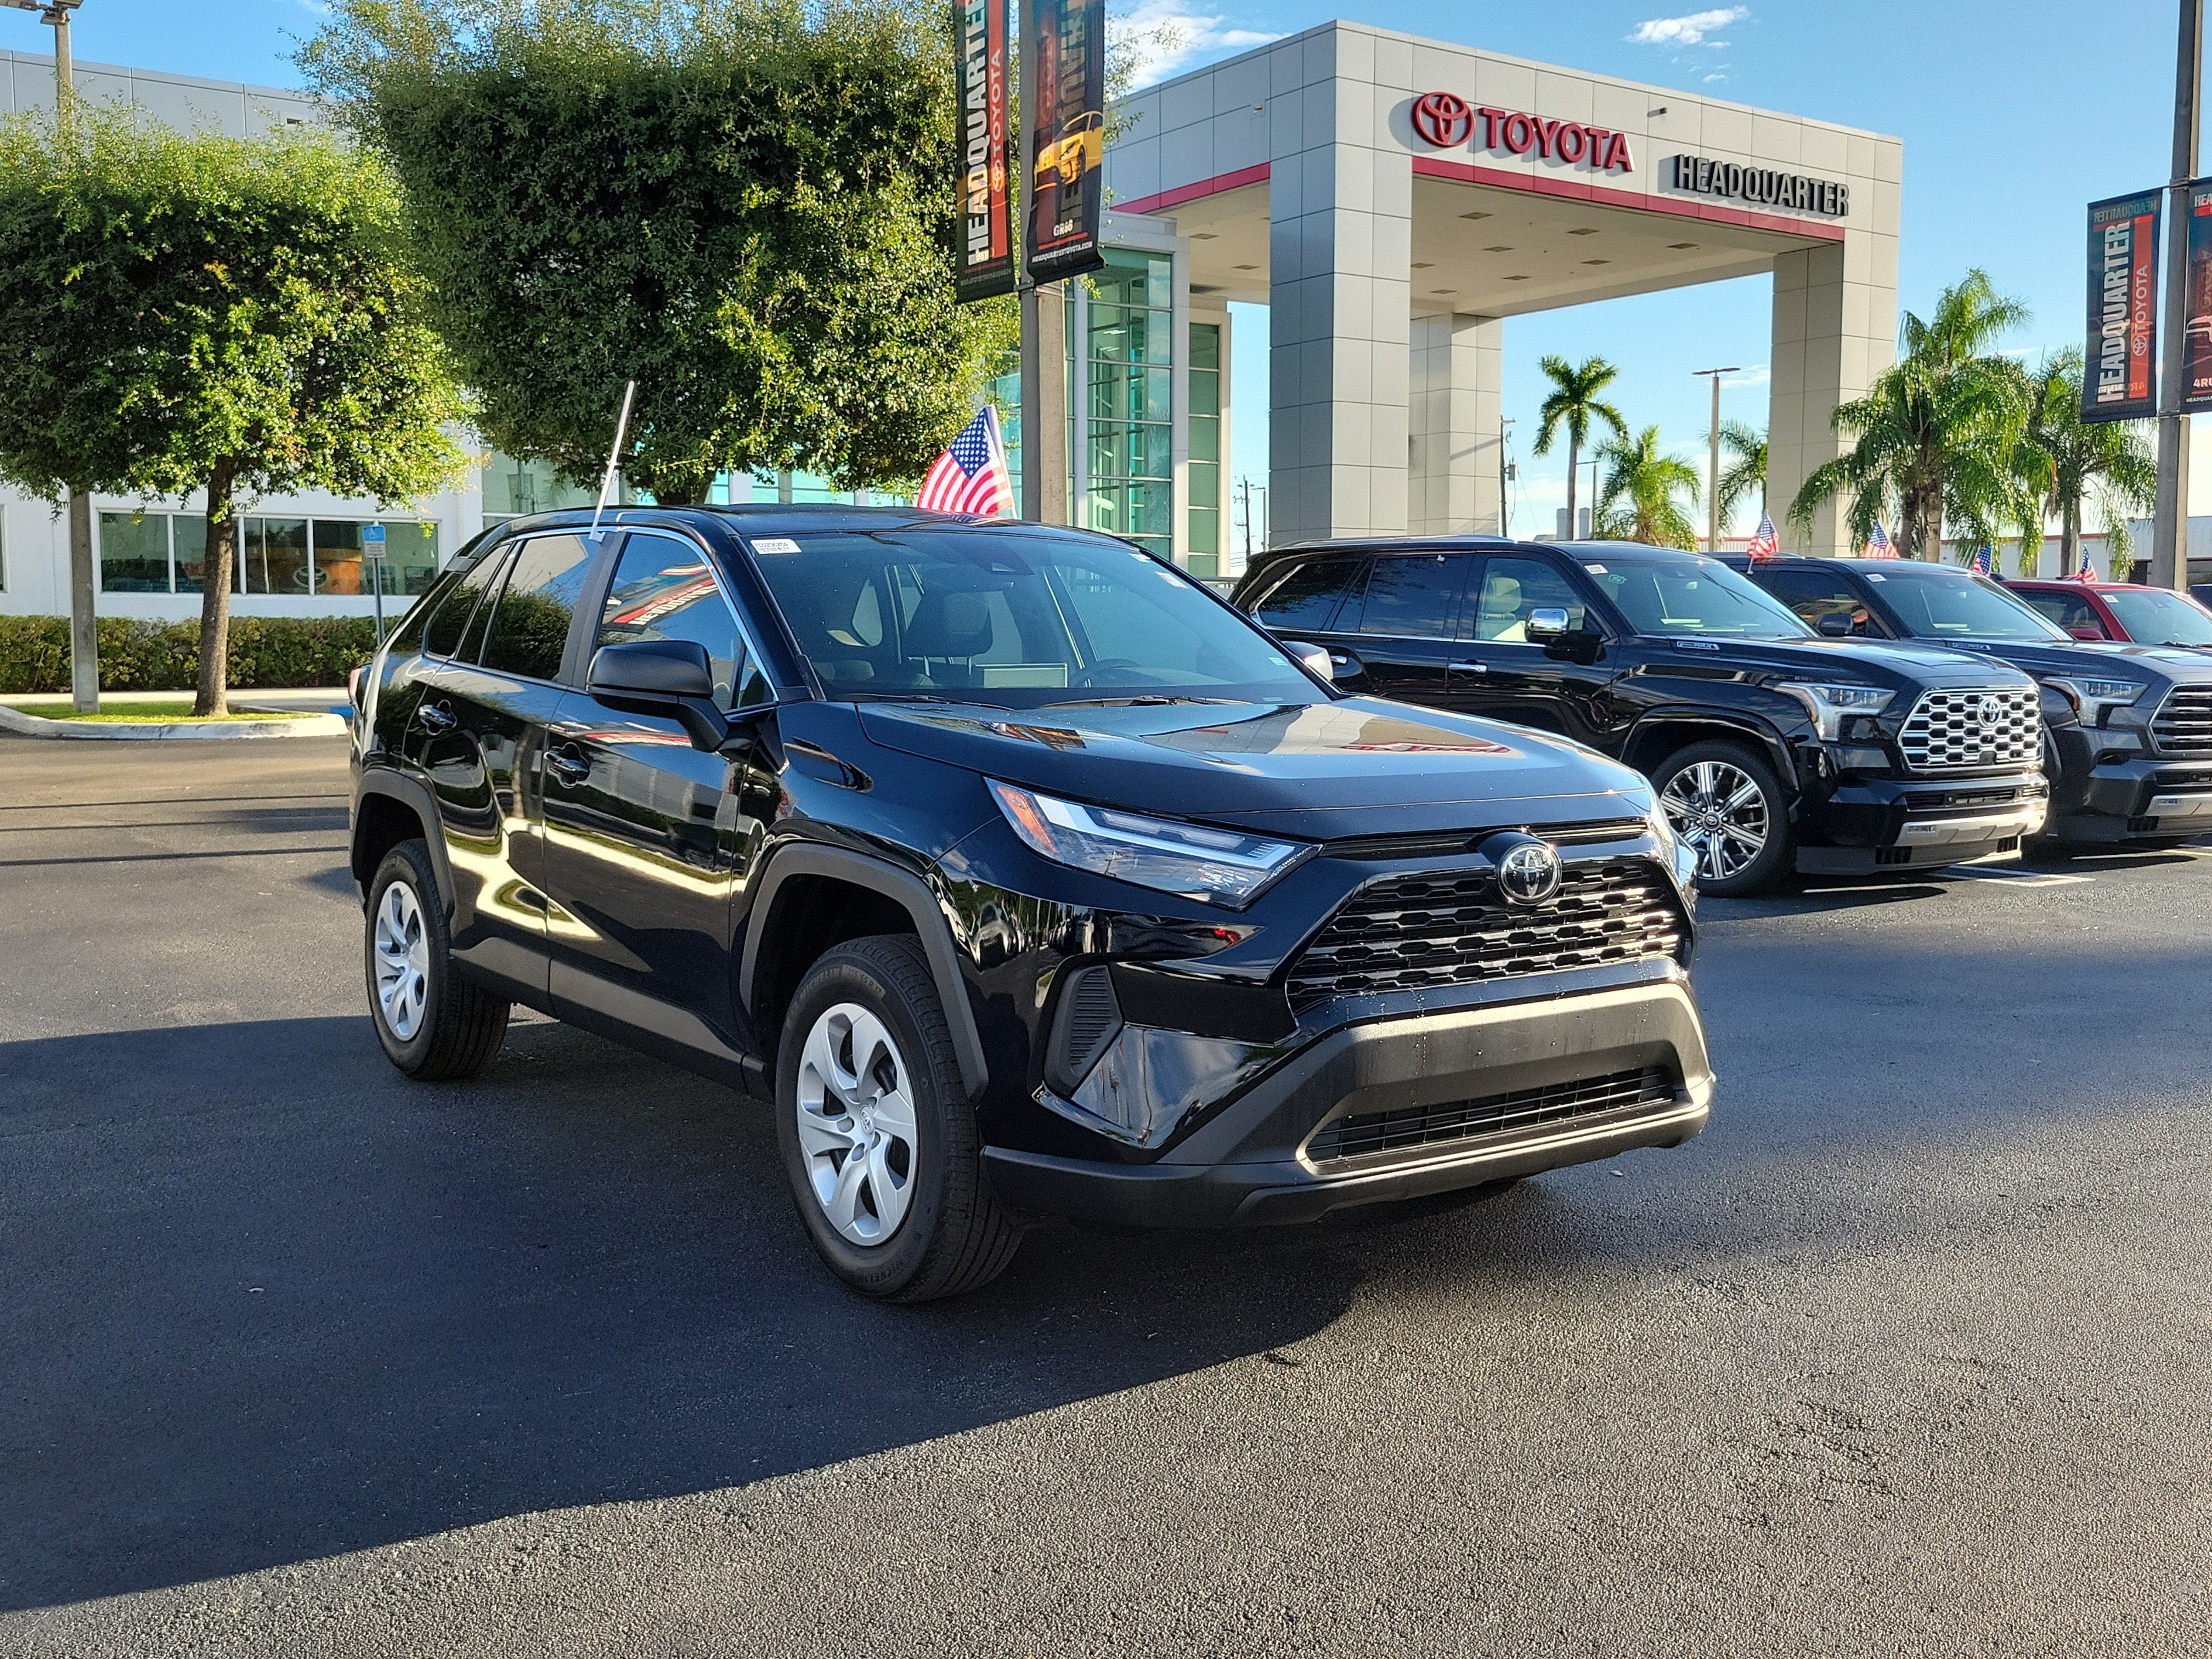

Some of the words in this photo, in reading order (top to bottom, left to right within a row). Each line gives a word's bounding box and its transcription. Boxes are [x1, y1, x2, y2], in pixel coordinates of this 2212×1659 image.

[992, 49, 1001, 160] TOYOTA
[1480, 107, 1635, 172] TOYOTA
[1676, 154, 1849, 216] HEADQUARTER
[2097, 220, 2131, 403] HEADQUARTER
[2135, 264, 2148, 333] TOYOTA
